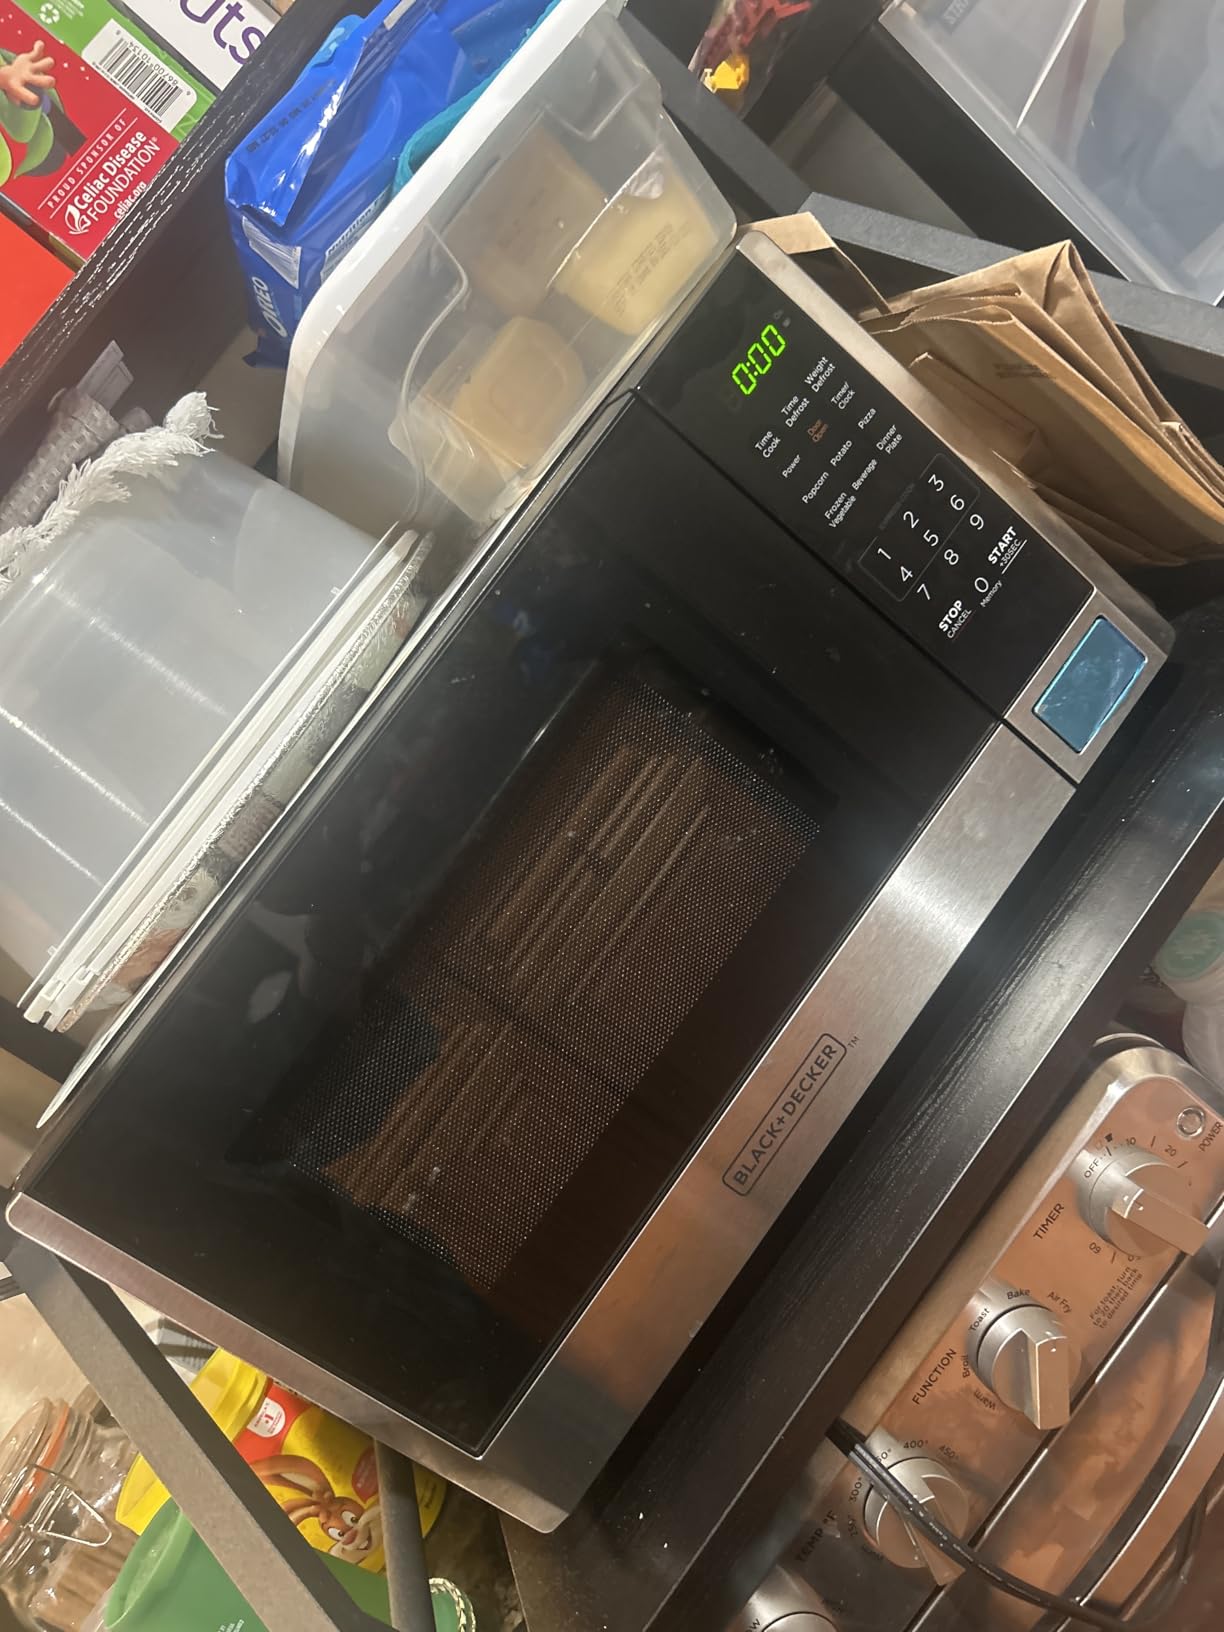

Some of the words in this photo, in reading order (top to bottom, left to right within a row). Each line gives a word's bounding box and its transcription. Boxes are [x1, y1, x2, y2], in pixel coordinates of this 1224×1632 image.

[47, 177, 76, 208] PROUD
[76, 134, 114, 175] SPONSOR
[115, 118, 127, 132] OF
[74, 172, 110, 210] Celiac
[102, 131, 147, 176] Disease
[114, 180, 147, 220] celiac.org
[252, 276, 288, 338] OREO
[731, 324, 786, 395] 0:00
[804, 356, 828, 386] Weight
[811, 363, 836, 392] Defrost
[780, 395, 798, 416] Time
[830, 381, 850, 406] Timer/
[838, 388, 856, 410] Clock
[785, 397, 810, 428] Defrost
[754, 430, 774, 452] Time
[762, 436, 781, 458] Cook
[876, 424, 898, 452] Dinner
[885, 433, 903, 454] Plate
[782, 454, 801, 478] Power
[802, 470, 830, 504] Popcorn
[830, 440, 852, 467] Potato
[858, 407, 876, 430] Pizza
[852, 458, 878, 491] Beverage
[824, 491, 848, 520] Frozen
[828, 494, 856, 530] Vegetable
[877, 547, 892, 561] 1
[903, 511, 920, 529] 2
[928, 474, 944, 492] 3
[898, 565, 913, 582] 4
[923, 529, 939, 548] 5
[949, 494, 965, 512] 6
[987, 526, 1017, 565] START
[917, 583, 932, 601] 7
[944, 548, 960, 566] 8
[969, 514, 985, 530] 9
[974, 576, 990, 594] 0
[980, 579, 1002, 608] Memory
[938, 600, 964, 633] STOP
[946, 608, 972, 640] CANCEL
[734, 1044, 838, 1186] BLACK+DECKER
[1164, 1144, 1177, 1157] 20
[1198, 1121, 1224, 1152] POWER
[1084, 1159, 1099, 1179] OFF
[1033, 1203, 1064, 1240] TIMER
[1006, 1288, 1031, 1300] Bake
[1047, 1290, 1062, 1305] Air
[1058, 1300, 1072, 1315] Fry
[1089, 1306, 1101, 1320] For
[1116, 1266, 1130, 1283] turn
[1092, 1317, 1101, 1328] to
[1102, 1306, 1110, 1317] 20
[1109, 1287, 1124, 1304] then
[1122, 1268, 1138, 1286] back
[1099, 1320, 1108, 1328] to
[1106, 1292, 1128, 1320] desired
[1128, 1274, 1143, 1290] time
[968, 1308, 990, 1332] Toast
[912, 1348, 958, 1405] FUNCTION
[962, 1354, 970, 1378] Broil
[974, 1389, 996, 1411] Warm
[876, 1448, 892, 1464] 50°
[903, 1440, 928, 1450] 400°
[795, 1526, 824, 1562] TEMP
